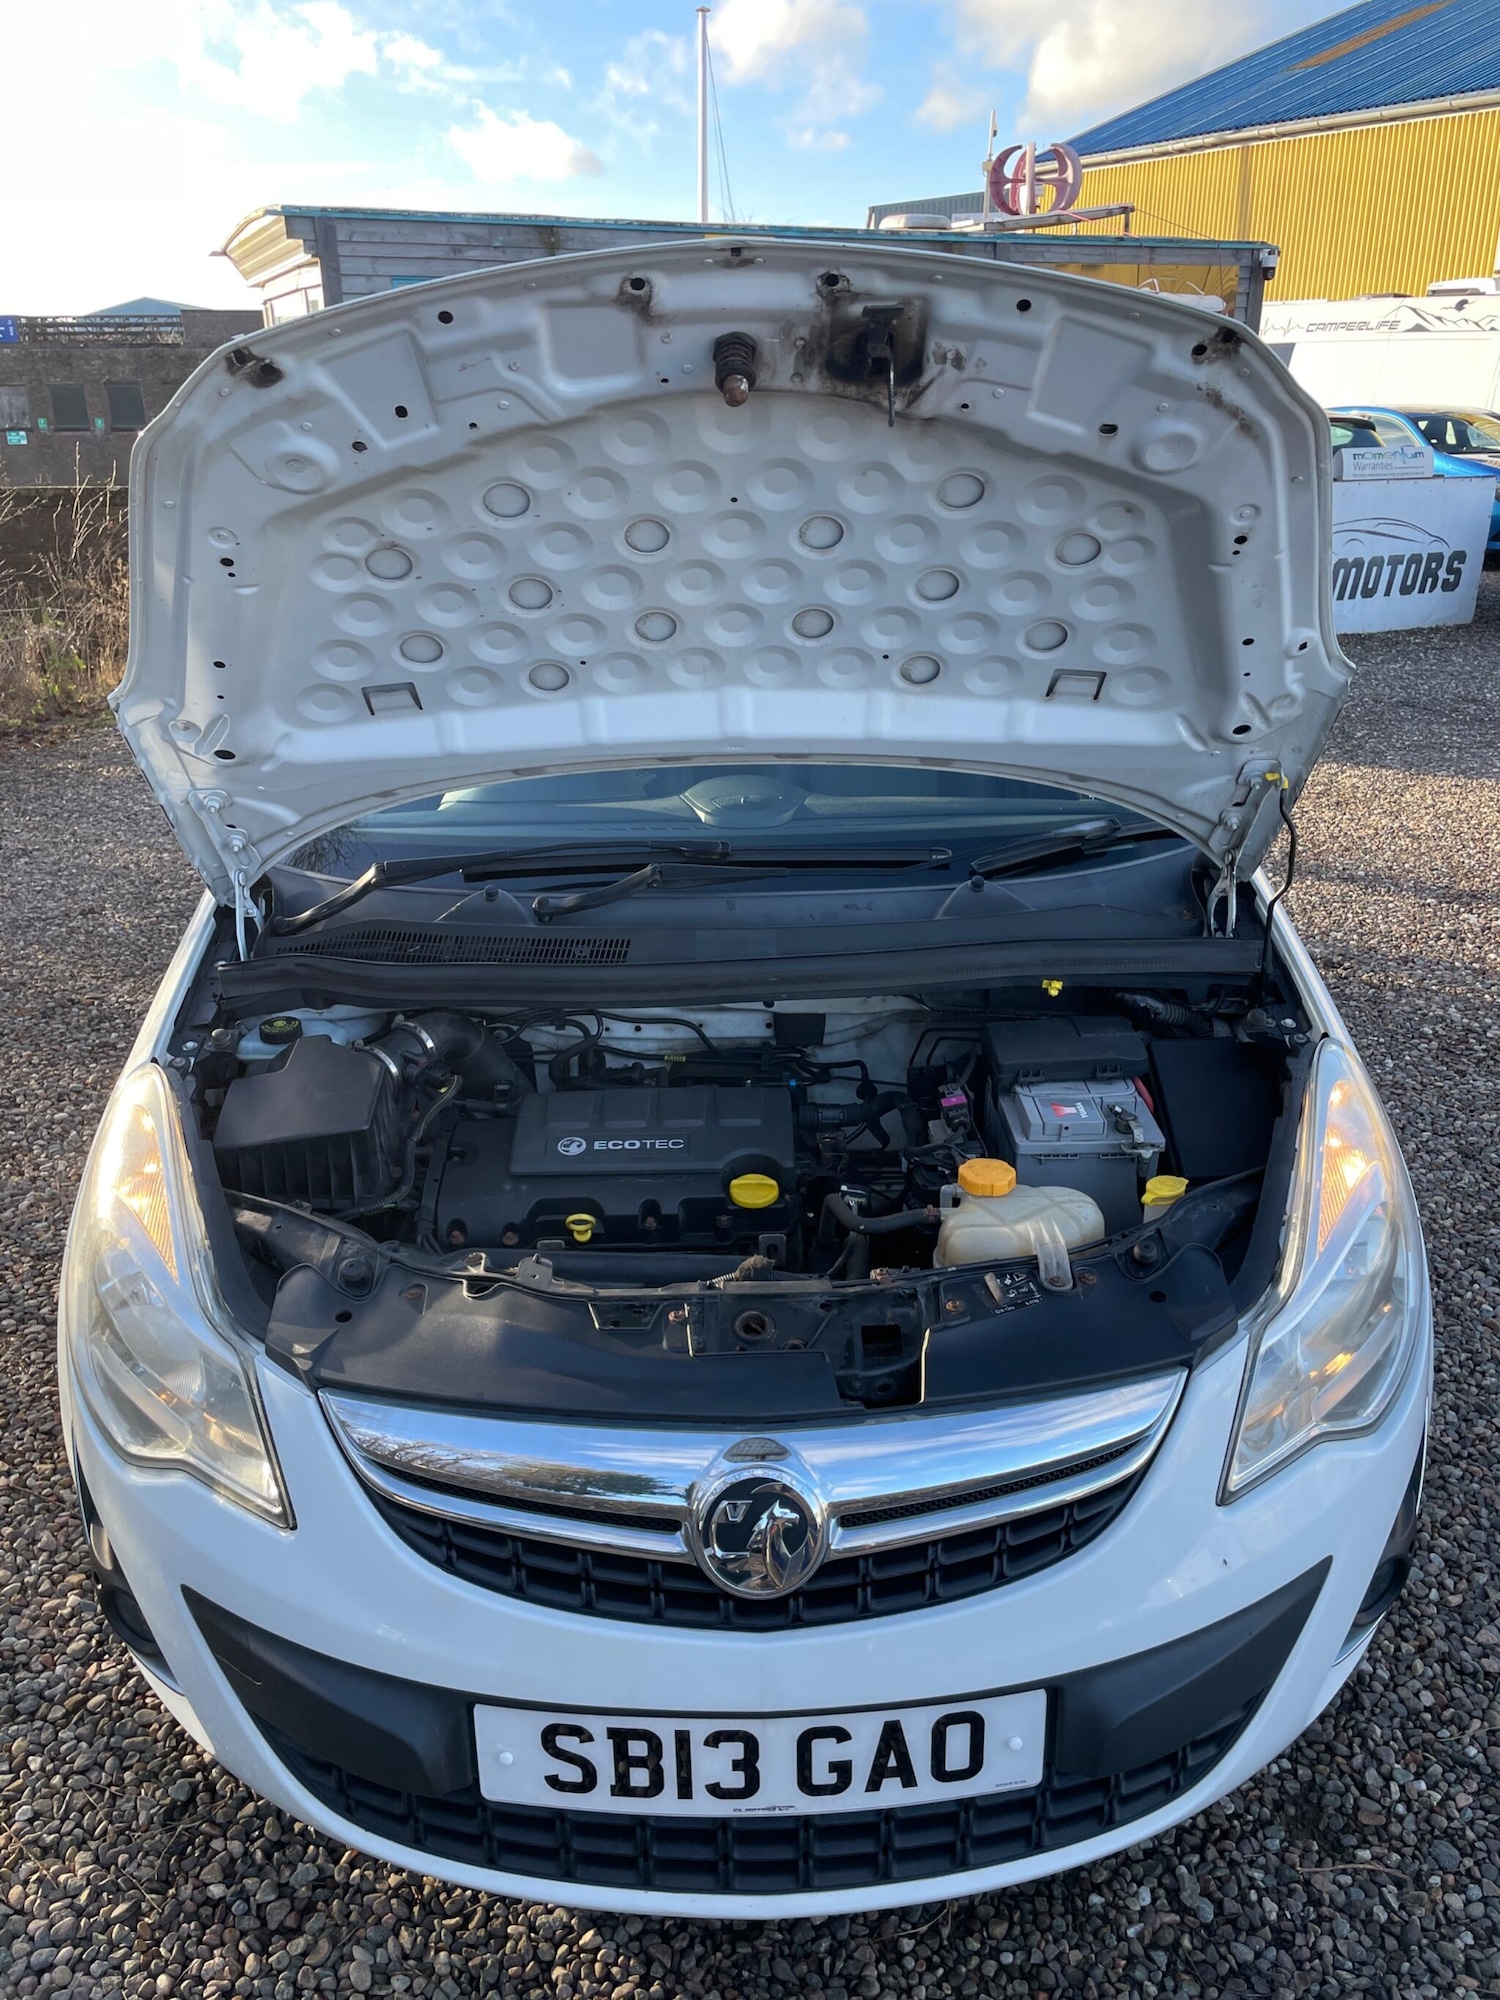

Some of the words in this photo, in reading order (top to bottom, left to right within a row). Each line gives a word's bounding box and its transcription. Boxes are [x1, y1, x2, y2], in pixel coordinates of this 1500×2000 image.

[1306, 320, 1400, 332] CAMPERLIFE
[1354, 461, 1393, 471] Warranties
[1333, 550, 1467, 601] MOTORS
[594, 1139, 684, 1150] ECOTEC
[541, 1723, 760, 1800] SB13
[796, 1711, 985, 1797] GAO
